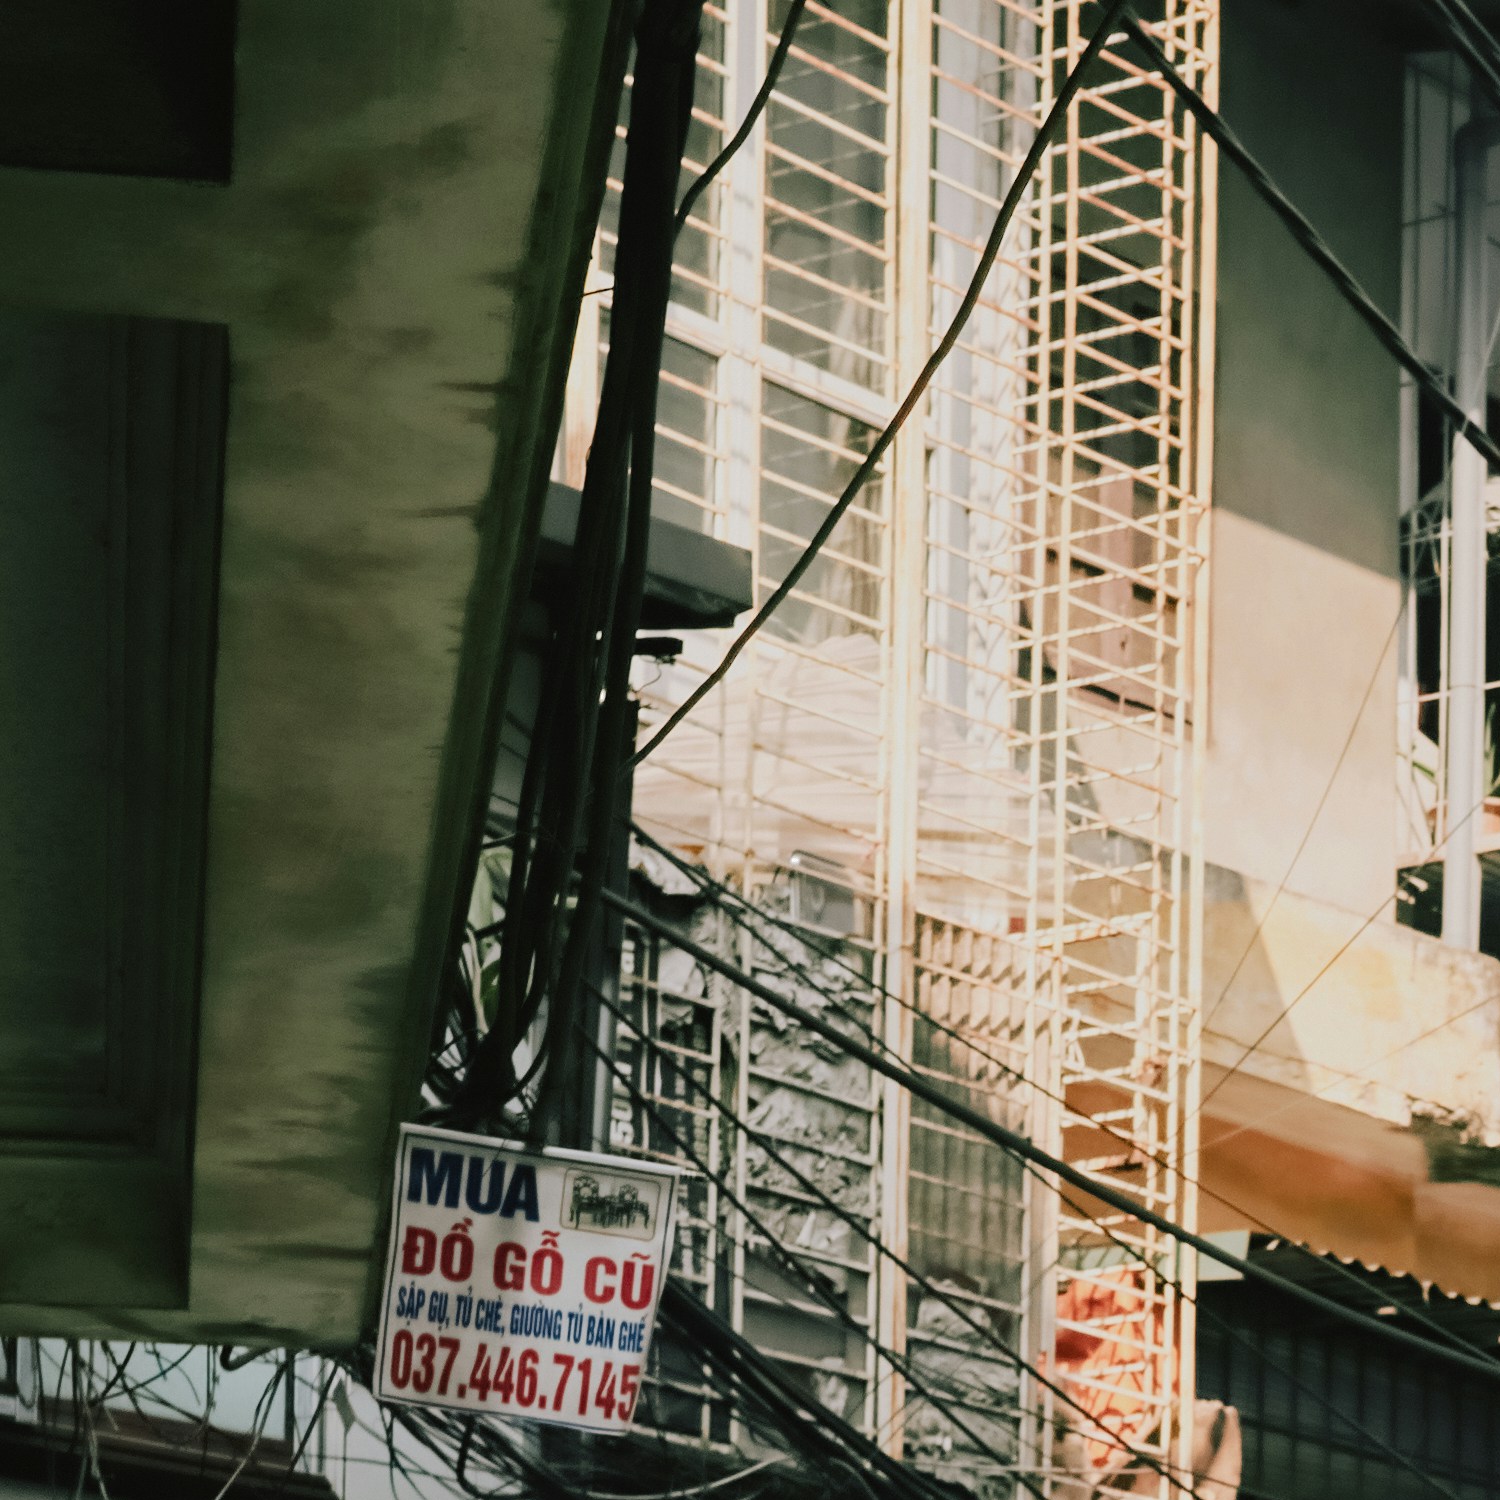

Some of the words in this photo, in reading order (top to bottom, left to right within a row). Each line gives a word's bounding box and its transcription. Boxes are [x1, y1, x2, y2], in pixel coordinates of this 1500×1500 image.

[407, 1147, 540, 1223] MUA
[401, 1217, 475, 1283] ĐỒ
[493, 1230, 564, 1296] GỖ
[583, 1252, 655, 1311] CŨ
[455, 1286, 473, 1328] TỦ
[510, 1300, 562, 1341] GIƯỜNG
[567, 1303, 584, 1344] TỦ
[586, 1310, 616, 1349] BÀN
[618, 1314, 648, 1353] GHẾ
[390, 1329, 641, 1422] 037.446.7145
